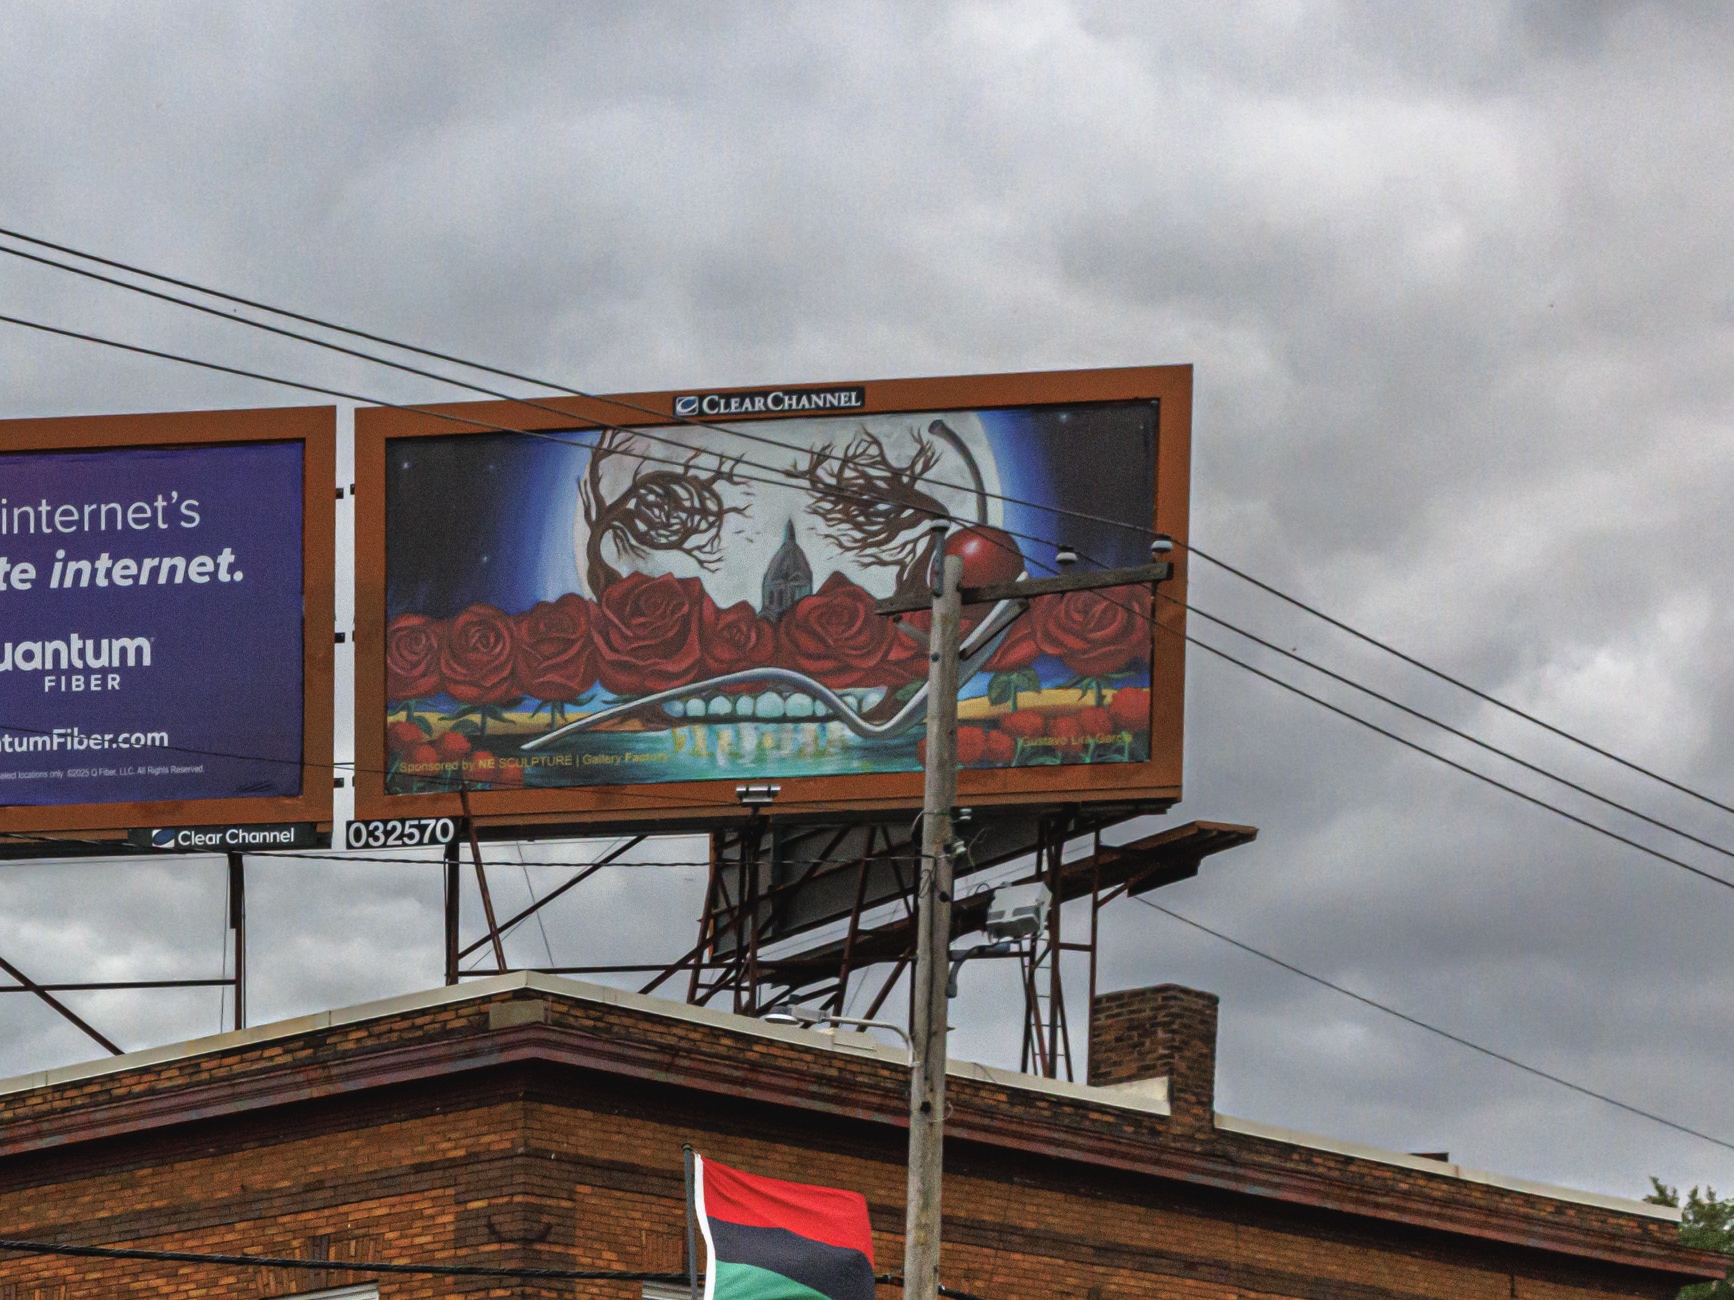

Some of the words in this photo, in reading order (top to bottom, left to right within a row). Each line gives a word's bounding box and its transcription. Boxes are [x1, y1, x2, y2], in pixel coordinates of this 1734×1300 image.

[1, 490, 201, 535] internet's
[48, 547, 245, 589] internet.
[44, 673, 121, 692] FIBER
[399, 761, 459, 774] Sponsored
[462, 761, 475, 772] by
[478, 760, 495, 769] NE
[499, 755, 572, 768] SCULPTURE
[178, 830, 223, 846] Clear
[226, 827, 295, 845] Channel
[348, 817, 455, 848] 032570
